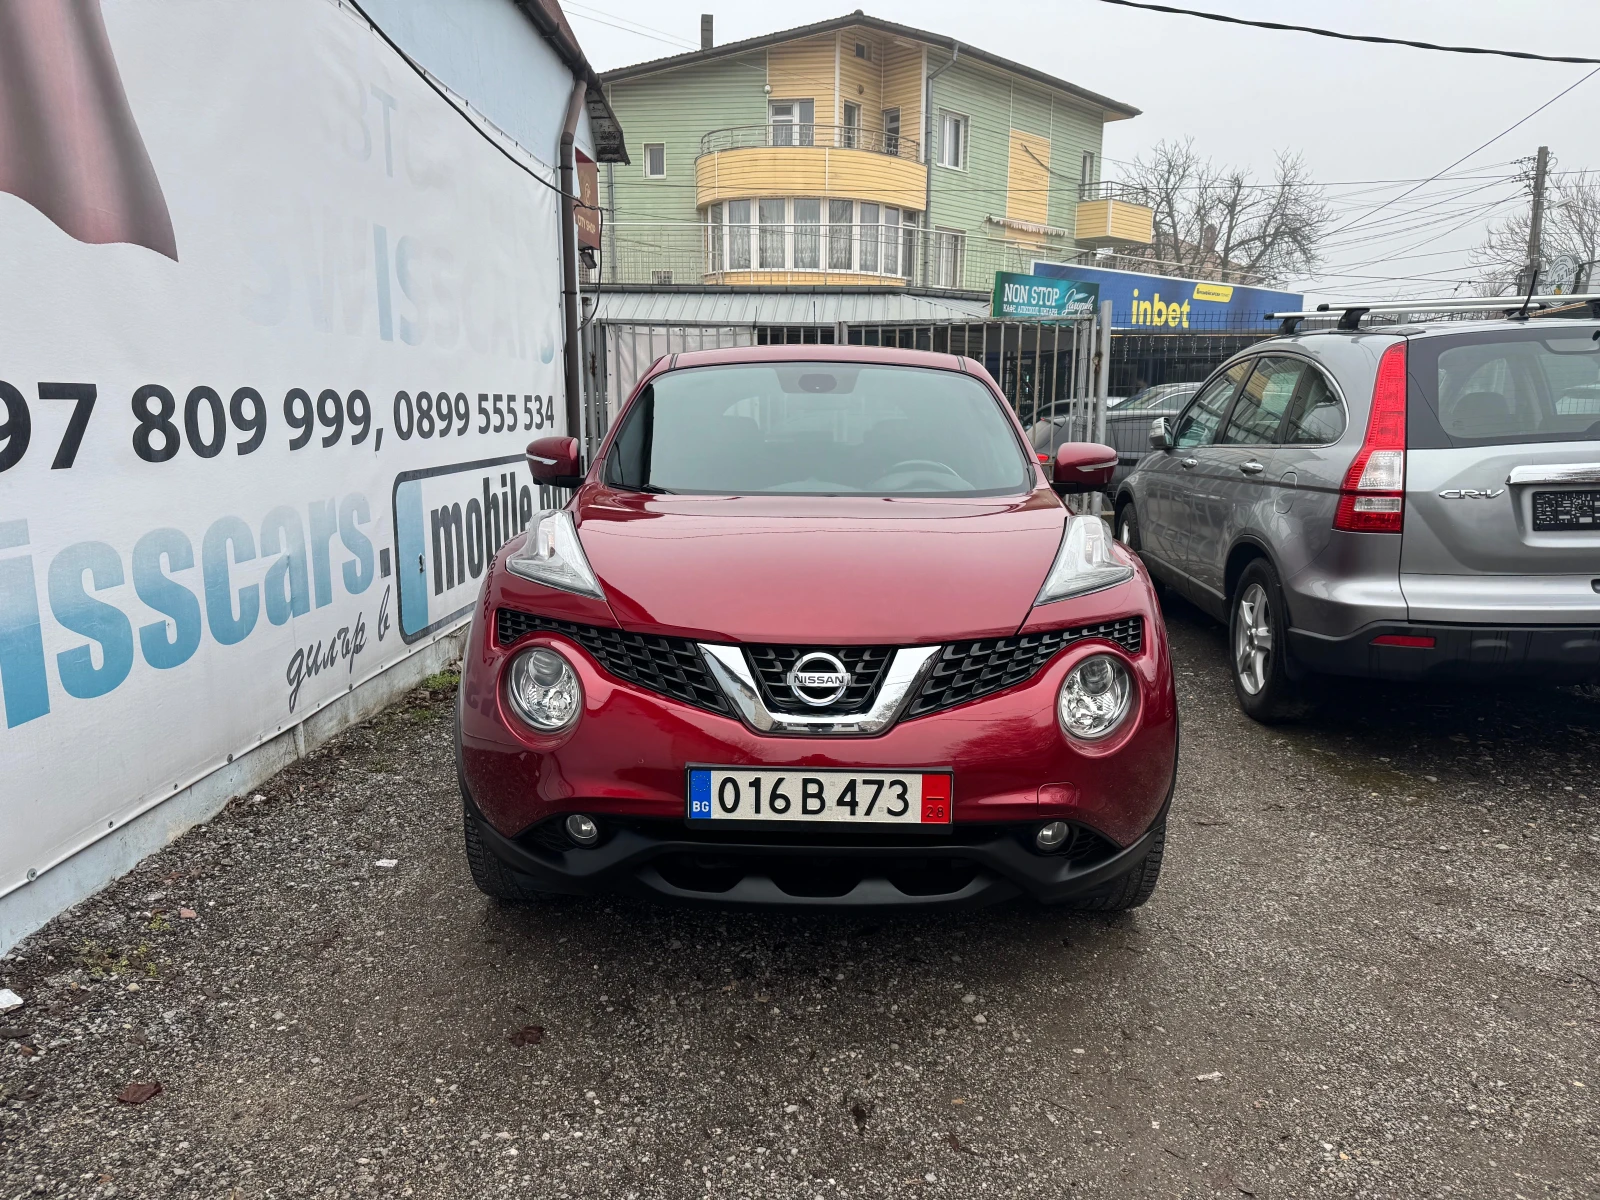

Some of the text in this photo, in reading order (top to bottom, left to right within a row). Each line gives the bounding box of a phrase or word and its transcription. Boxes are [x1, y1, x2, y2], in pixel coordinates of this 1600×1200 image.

[1003, 283, 1060, 306] NON STOP
[1131, 288, 1191, 329] inbet
[131, 384, 267, 463] 809
[283, 387, 384, 452] 999,
[393, 390, 470, 441] 0899
[477, 393, 518, 434] 555
[523, 394, 555, 430] 534
[1439, 489, 1505, 499] CR-V
[793, 675, 844, 684] NISSAN
[692, 801, 710, 812] BG
[926, 805, 944, 818] 28
